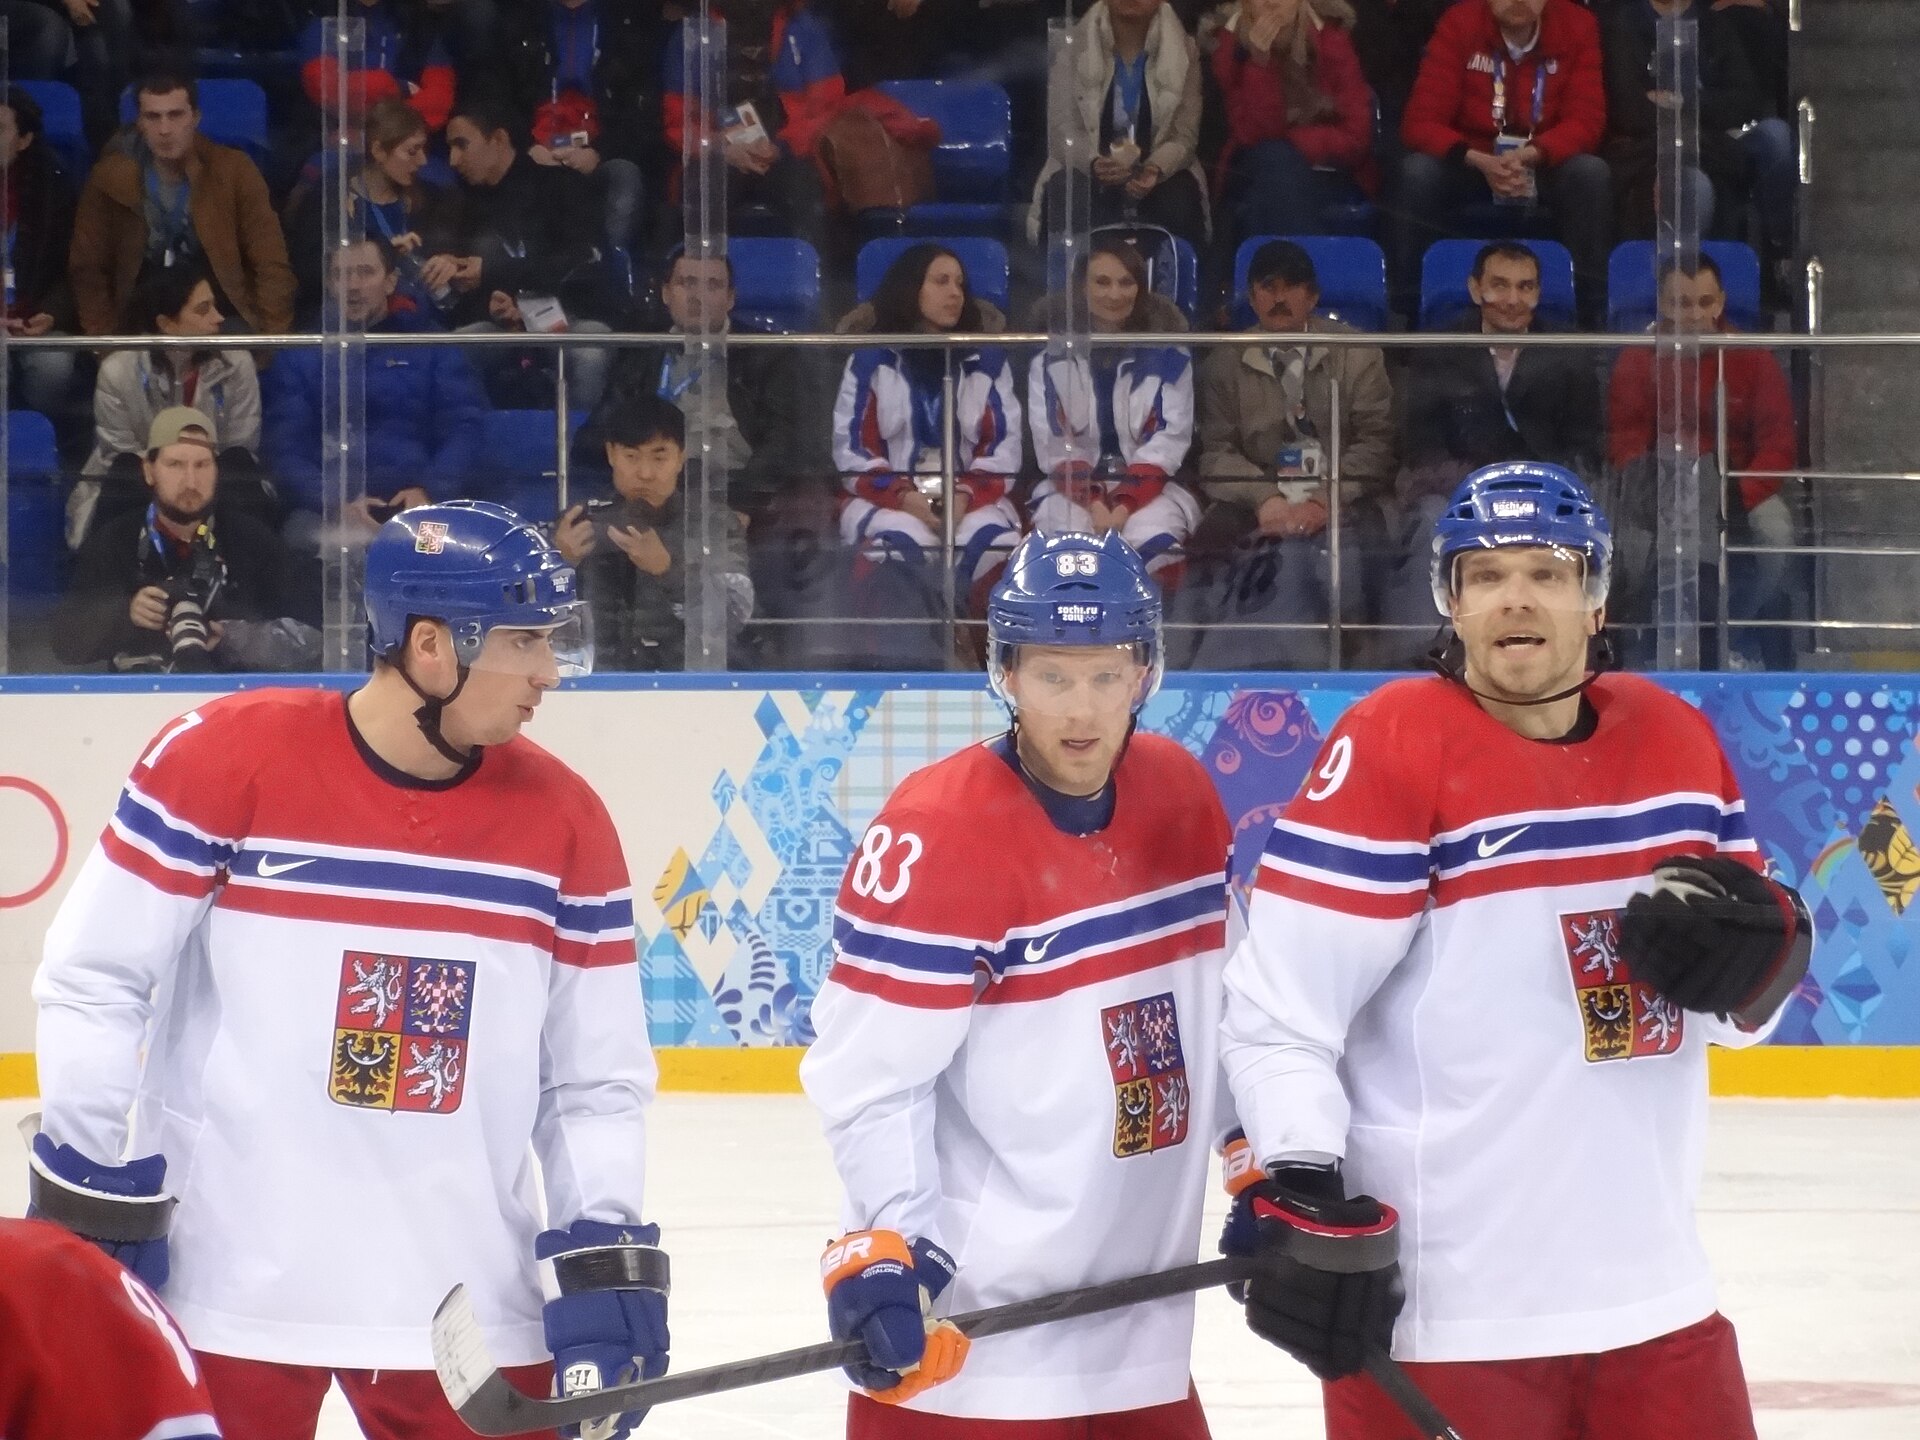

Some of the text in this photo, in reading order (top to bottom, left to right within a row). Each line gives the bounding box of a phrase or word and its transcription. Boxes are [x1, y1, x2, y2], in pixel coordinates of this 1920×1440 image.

[1056, 552, 1098, 577] 83
[1057, 604, 1098, 614] sochi.ru
[1062, 613, 1084, 623] 2014
[1305, 734, 1352, 801] 9
[851, 824, 923, 904] 83
